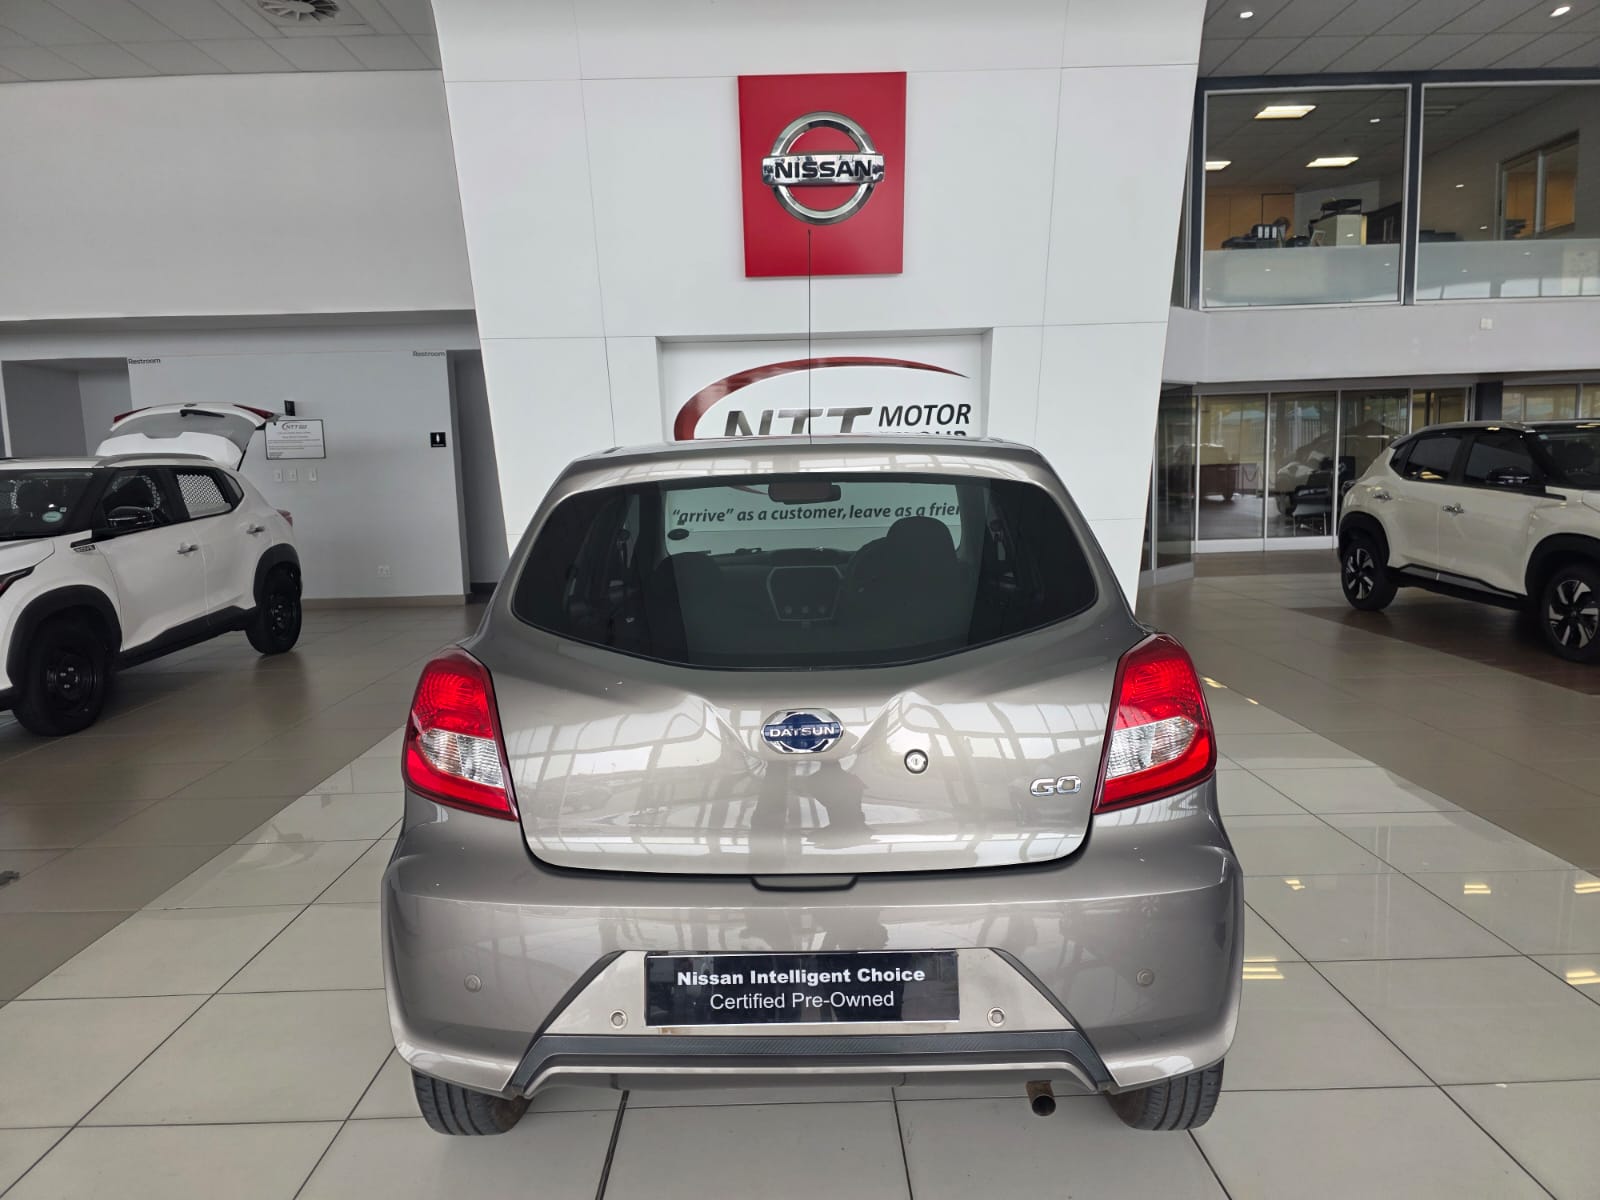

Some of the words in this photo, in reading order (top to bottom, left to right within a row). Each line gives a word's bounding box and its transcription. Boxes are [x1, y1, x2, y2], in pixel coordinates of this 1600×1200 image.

[774, 160, 872, 178] NISSAN
[724, 406, 874, 437] NTT
[878, 403, 972, 428] MOTOR
[736, 510, 755, 521] as
[757, 510, 768, 521] a
[770, 506, 846, 520] customer,
[850, 504, 892, 518] leave
[894, 506, 912, 518] as
[915, 506, 926, 517] a
[769, 726, 835, 737] DATSUN
[1030, 775, 1081, 797] GO
[677, 970, 744, 986] Nissan
[750, 969, 852, 987] Intelligent
[857, 967, 926, 983] Choice
[709, 992, 786, 1010] Certified
[791, 991, 895, 1008] Pre-Owned
